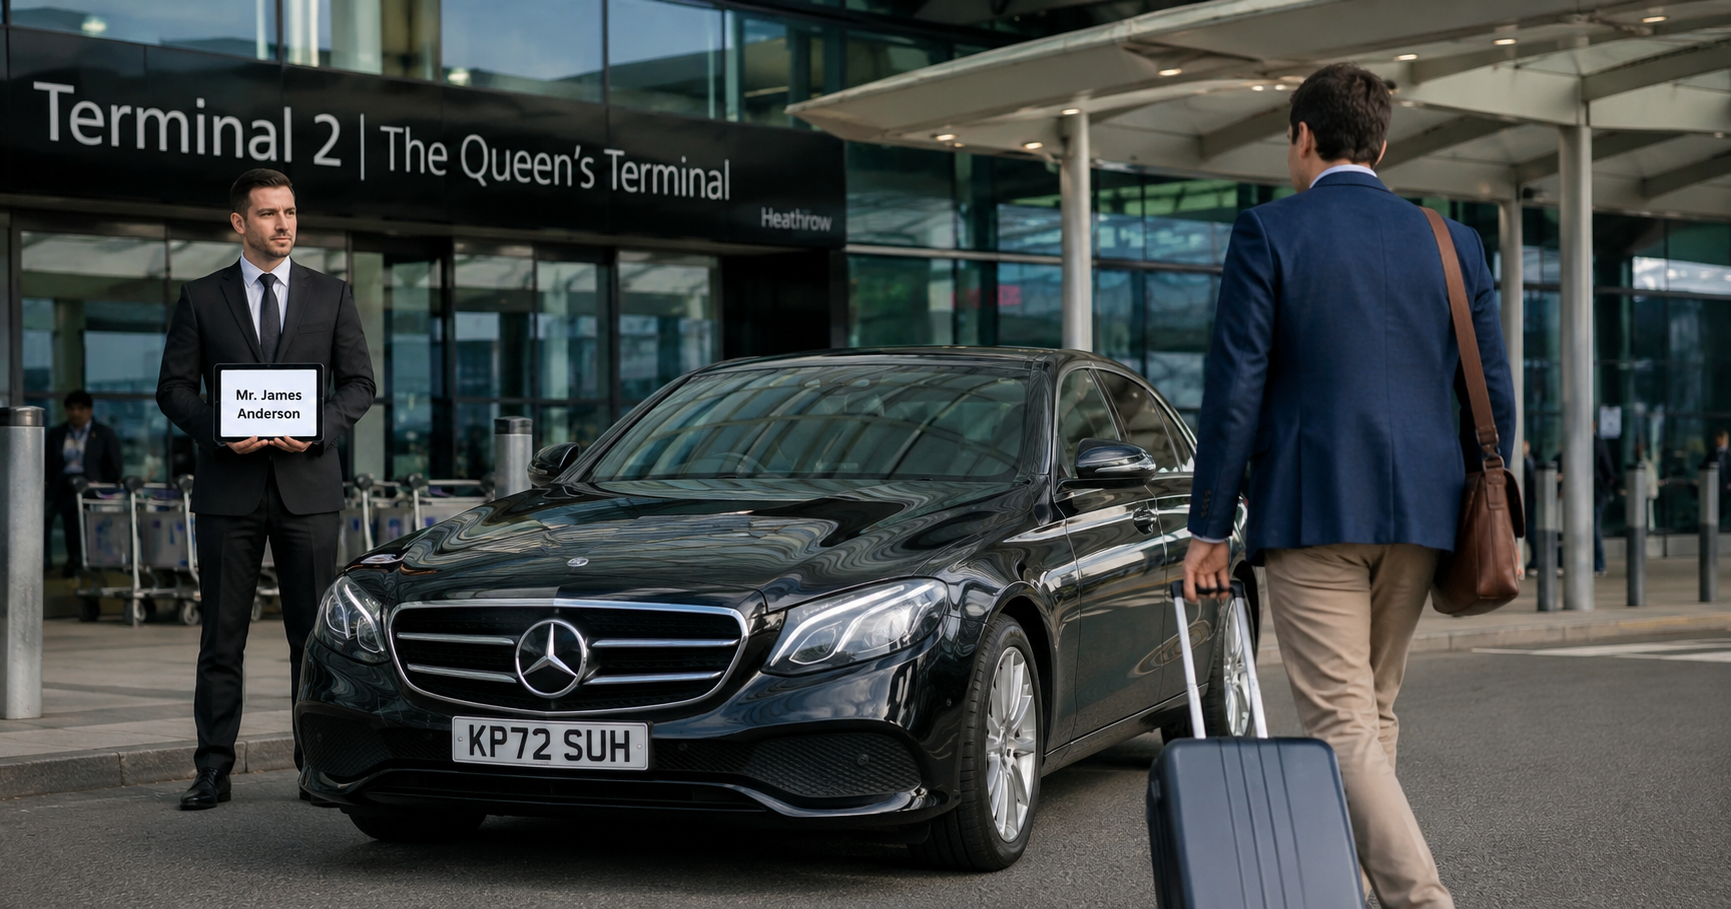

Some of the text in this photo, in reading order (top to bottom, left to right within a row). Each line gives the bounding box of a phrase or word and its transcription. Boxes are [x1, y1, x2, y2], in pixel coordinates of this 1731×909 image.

[33, 81, 730, 200] Terminal 2 The Queen's Terminal
[761, 207, 832, 232] Heathrow
[236, 389, 302, 401] Mr. James
[237, 408, 301, 419] Anderson
[469, 724, 630, 762] KP72 SUH
